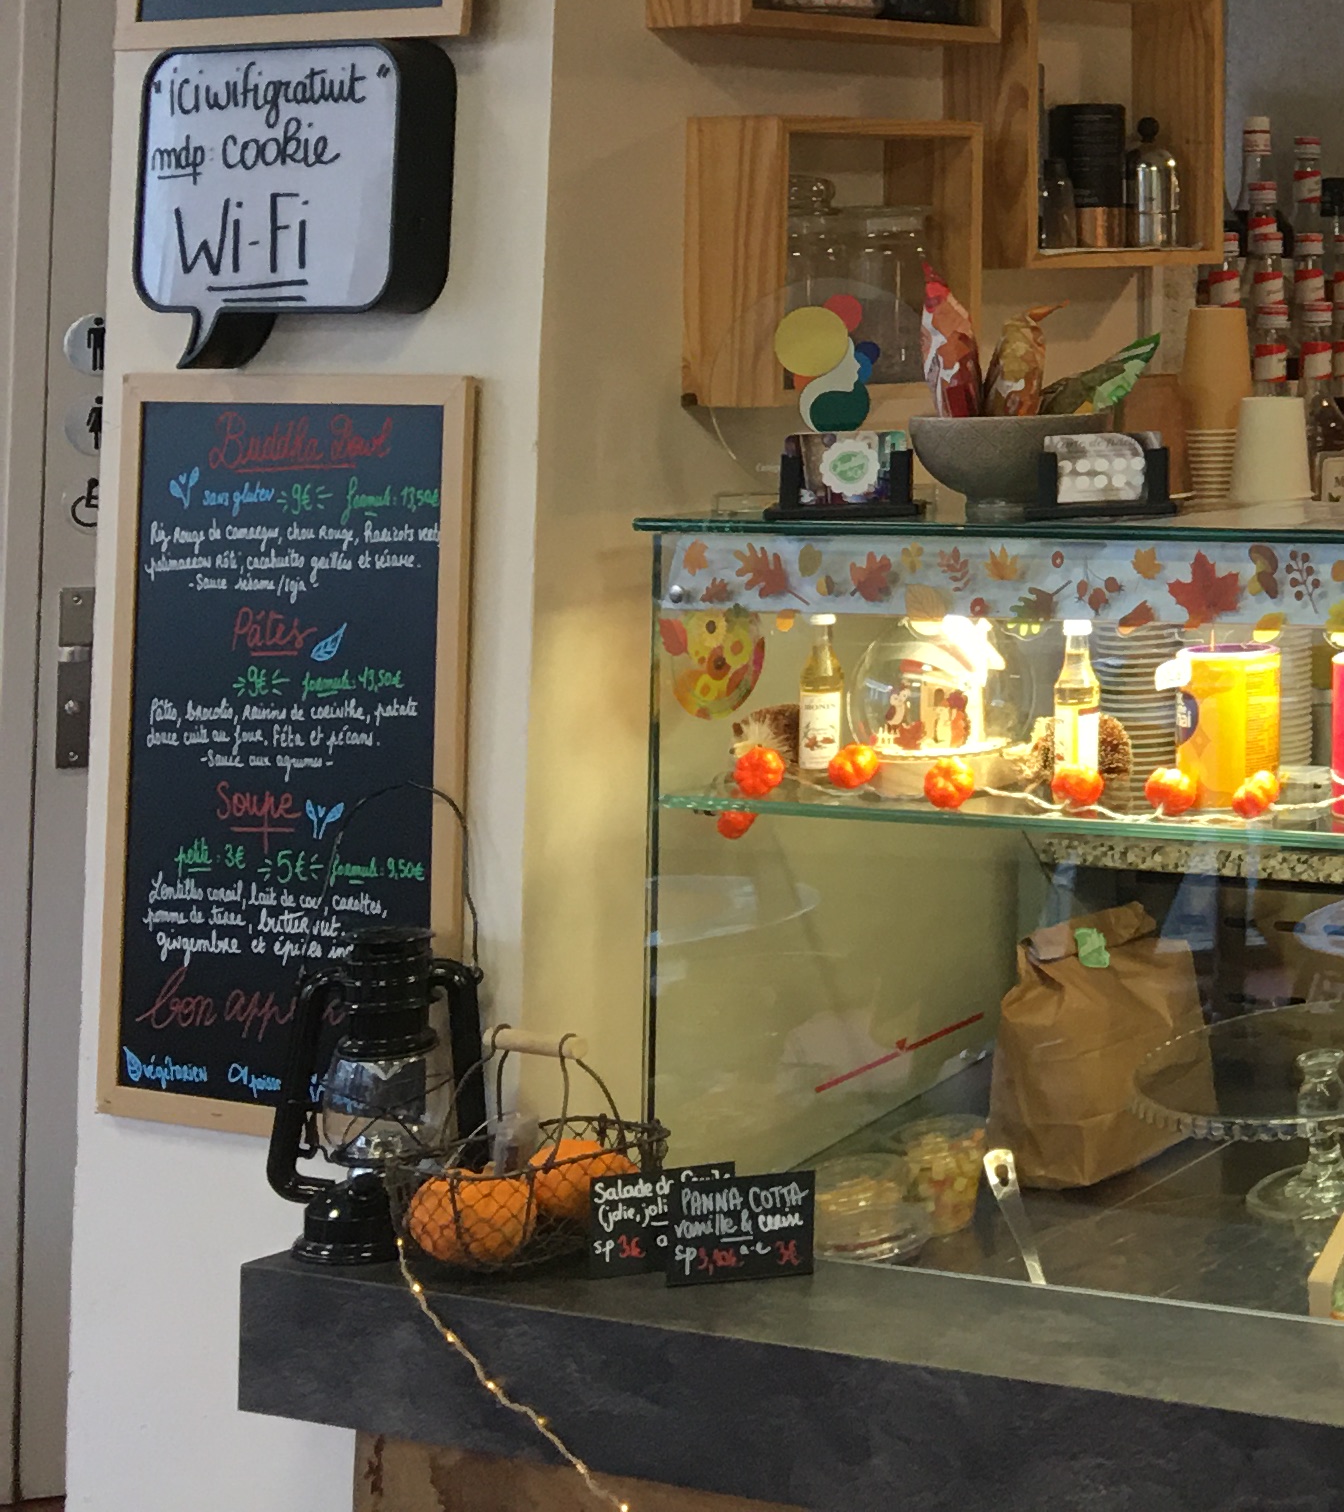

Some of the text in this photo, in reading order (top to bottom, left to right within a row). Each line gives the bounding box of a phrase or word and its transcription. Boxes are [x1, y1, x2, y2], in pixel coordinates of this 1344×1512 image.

[222, 117, 341, 170] cookie
[174, 193, 309, 276] Wi-Fi
[232, 607, 318, 650] Pâtes
[216, 781, 301, 854] Soupe
[681, 1182, 808, 1216] PANNA COTTA
